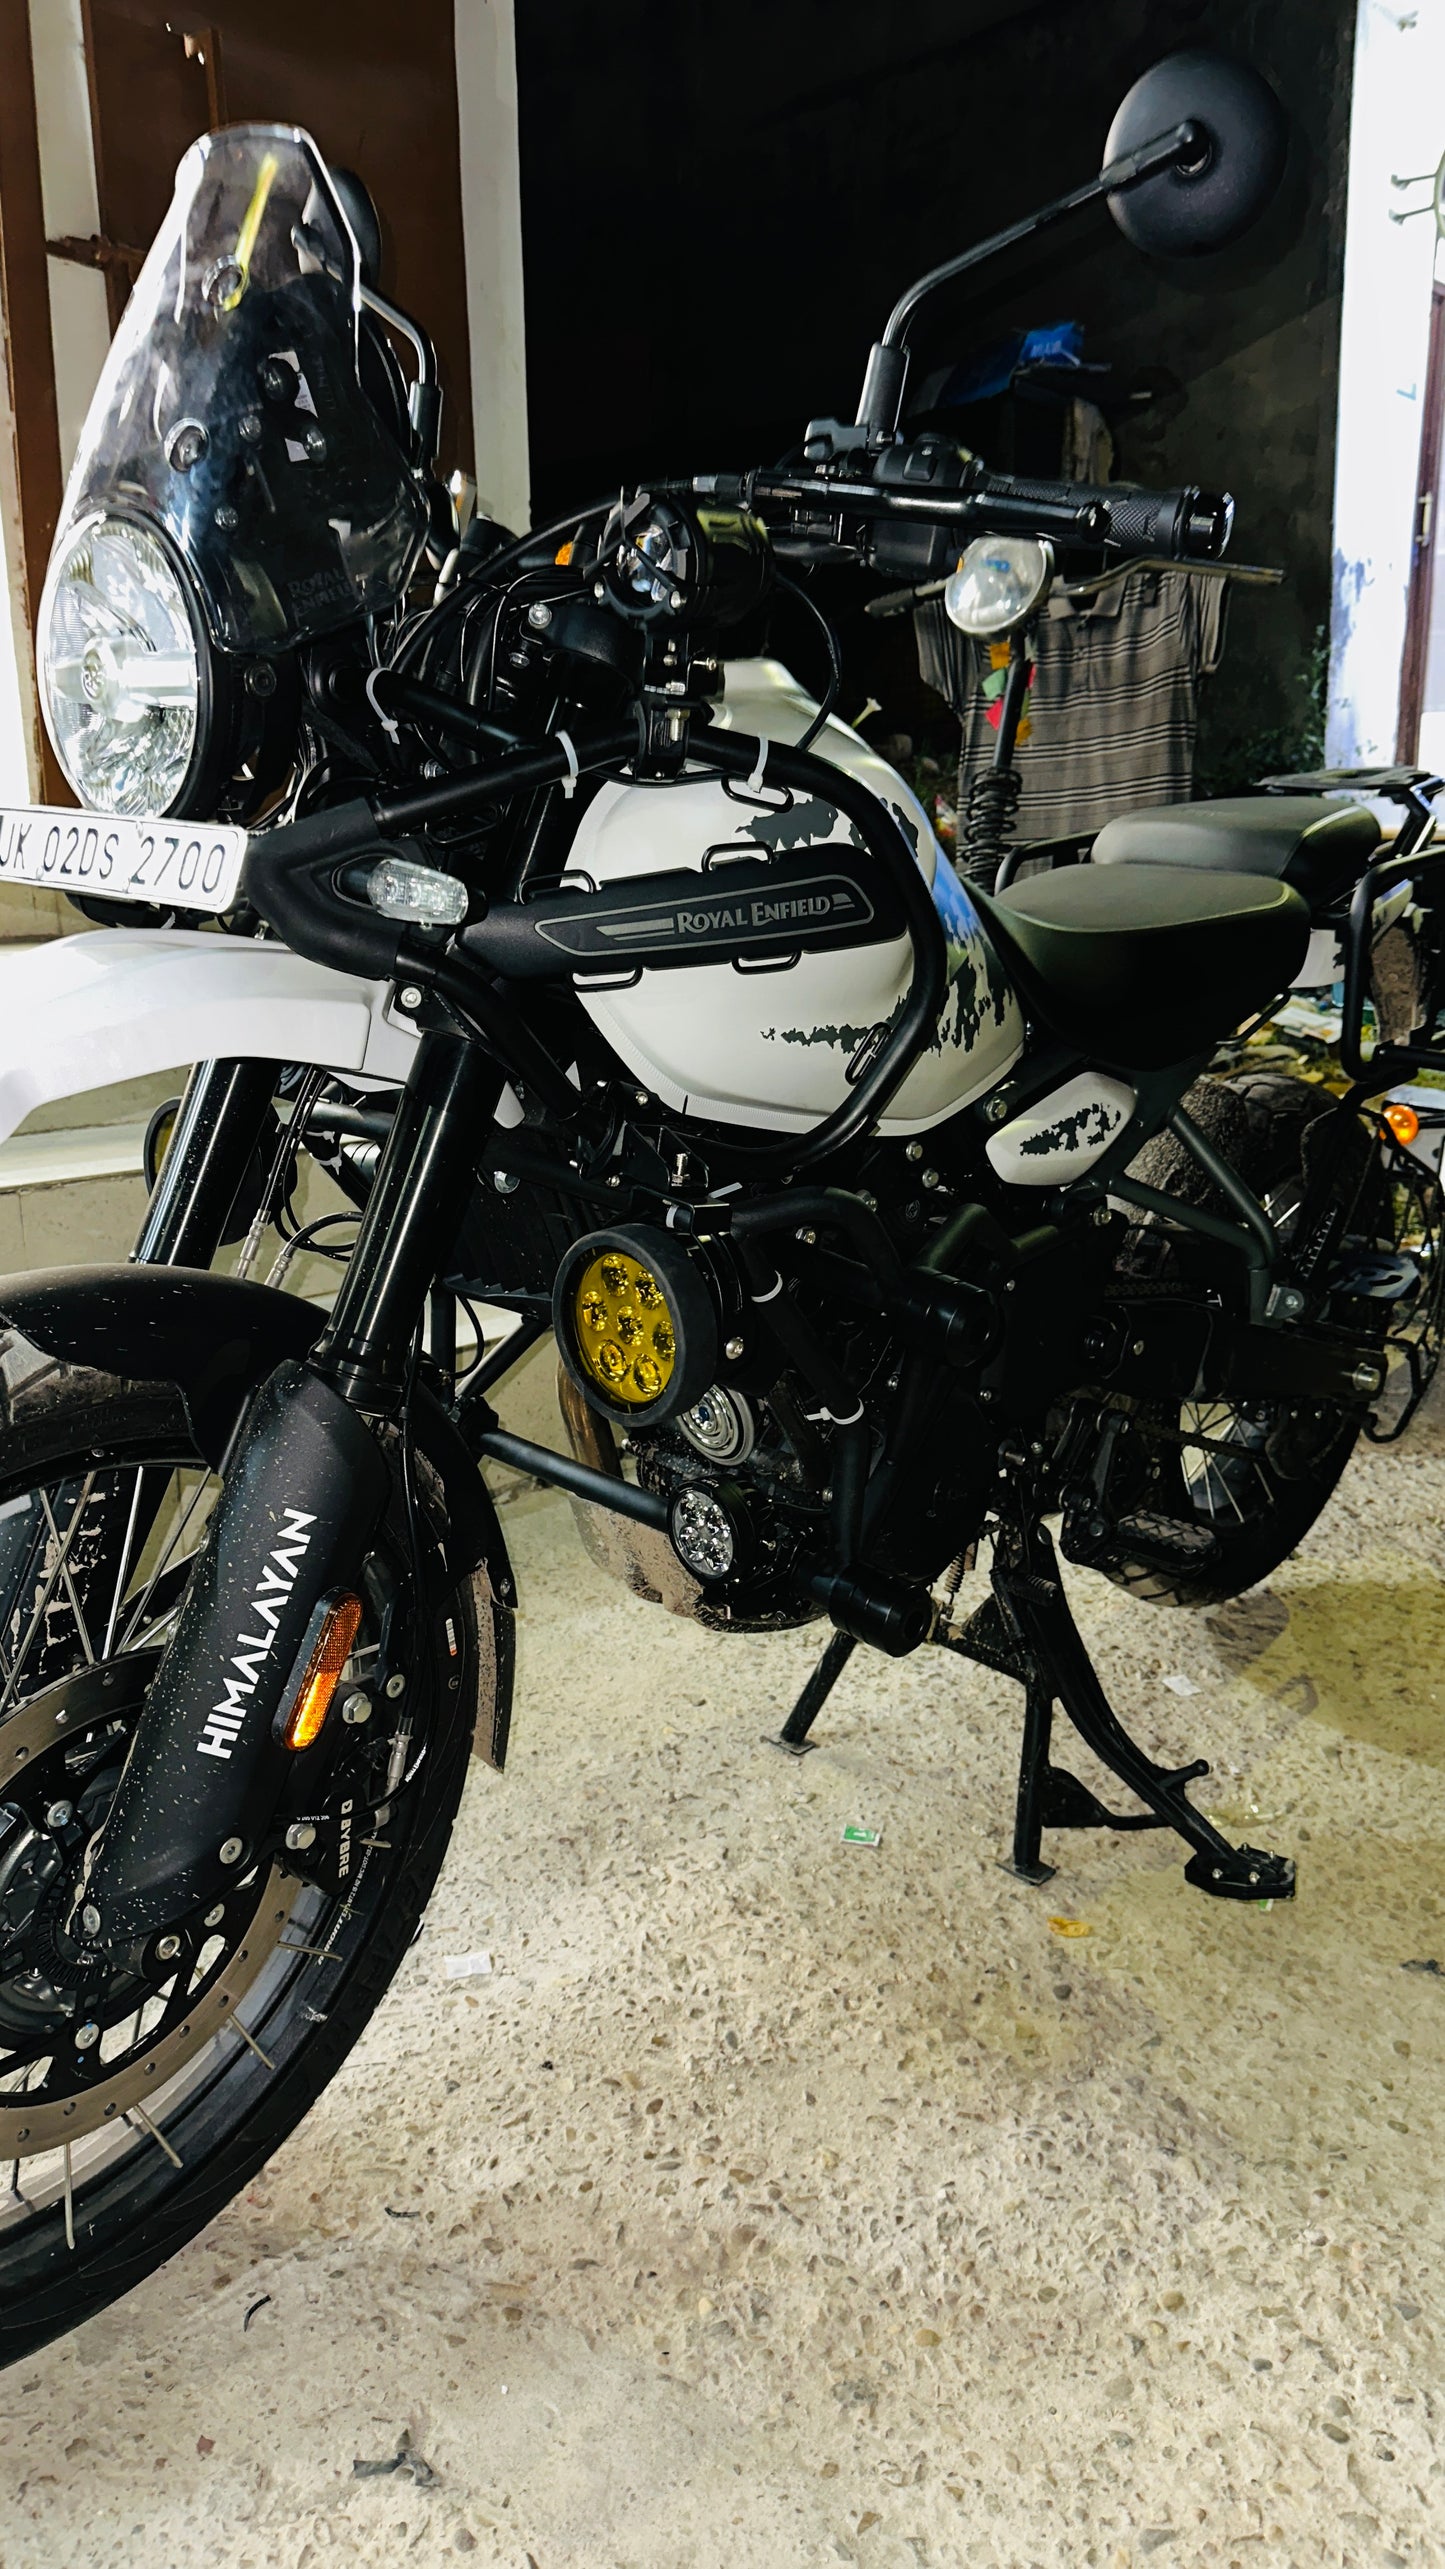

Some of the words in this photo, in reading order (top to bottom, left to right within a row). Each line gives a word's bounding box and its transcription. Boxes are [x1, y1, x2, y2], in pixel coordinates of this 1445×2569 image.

[43, 826, 119, 880] 02DS
[131, 836, 226, 894] 2700
[677, 909, 748, 934] ROYAL
[752, 896, 831, 927] ENFIELD
[196, 1507, 318, 1759] HIMALAYAN
[338, 1818, 352, 1879] BYBRE
